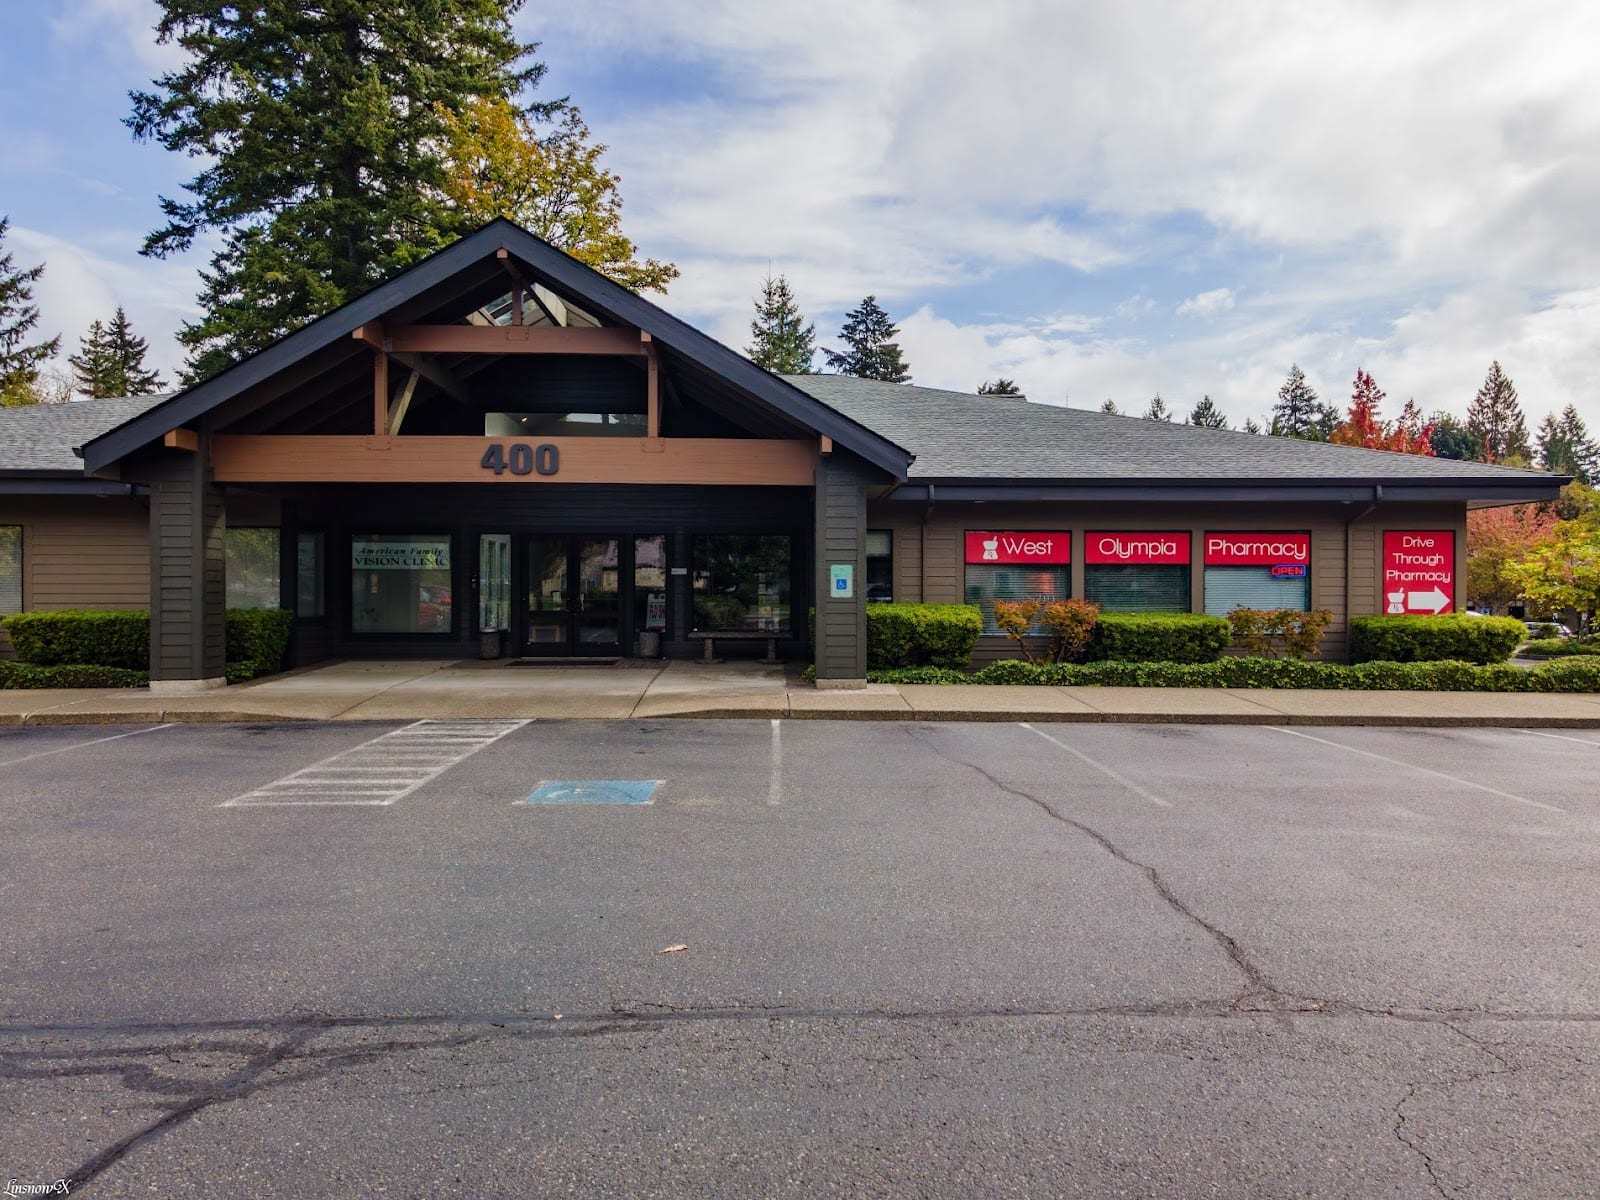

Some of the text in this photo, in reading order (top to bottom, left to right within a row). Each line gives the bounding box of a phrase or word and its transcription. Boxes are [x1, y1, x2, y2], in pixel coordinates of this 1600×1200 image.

[481, 444, 559, 475] 400
[1403, 536, 1435, 547] Drive
[359, 546, 444, 556] American Family
[1002, 538, 1306, 560] West Olympia Pharmacy
[354, 557, 448, 566] VISION CLINIC
[1392, 553, 1444, 566] Through
[1271, 567, 1303, 575] OPEN
[1387, 570, 1451, 583] Pharmacy
